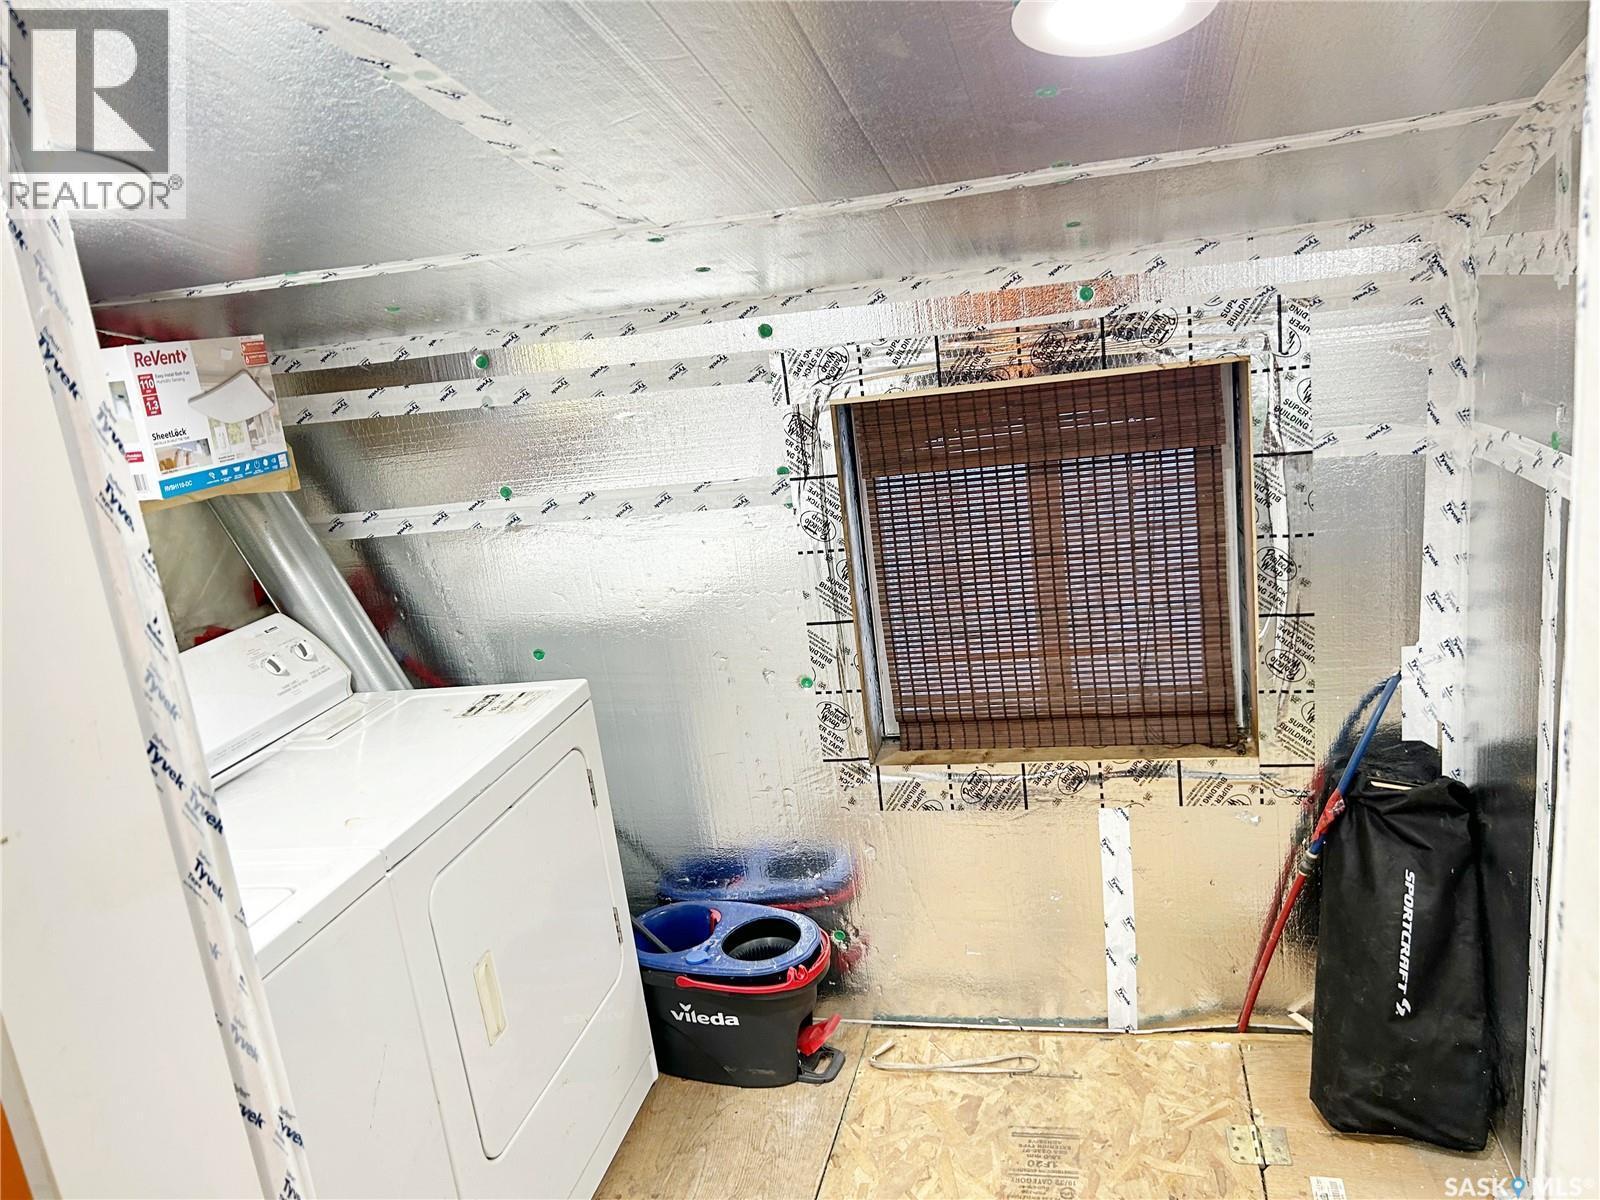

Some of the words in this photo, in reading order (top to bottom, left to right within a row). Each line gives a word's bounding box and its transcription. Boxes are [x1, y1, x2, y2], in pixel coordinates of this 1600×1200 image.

[1348, 223, 1375, 240] Tyvek
[1294, 237, 1319, 254] Tyvek
[1431, 252, 1448, 277] Tyvek
[1352, 285, 1378, 301] Tyvek
[1439, 305, 1456, 329] Tyvek
[38, 332, 83, 400] Tyvek
[134, 350, 182, 367] ReVent
[668, 364, 687, 381] Tyvek
[140, 379, 154, 390] 110
[146, 401, 159, 411] 1.3
[1283, 398, 1308, 415] SUPER
[1274, 405, 1309, 429] BUILDING
[152, 428, 187, 441] SheetLock
[1365, 424, 1391, 440] Tyvek
[1438, 452, 1455, 476] Tyvek
[1446, 502, 1463, 525] Tyvek
[1424, 545, 1440, 567] Tyvek
[819, 582, 849, 602] BUILDING
[1267, 579, 1288, 597] STICK
[1267, 592, 1285, 607] TAPE
[1430, 592, 1445, 613] Tyvek
[145, 668, 182, 722] Tyvek
[821, 713, 840, 729] Wrap
[1288, 718, 1311, 734] SUPER
[827, 731, 845, 745] STICK
[1278, 722, 1311, 746] BUILDING
[829, 740, 844, 753] TAPE
[146, 740, 187, 791] Tyvek
[900, 782, 921, 809] BUILDING
[912, 788, 927, 809] SUPER
[189, 788, 224, 834] Tyvek
[194, 858, 224, 902] Tyvek
[1398, 869, 1416, 995] SPORTCRAFT
[670, 1002, 740, 1026] vileda
[1027, 1160, 1058, 1169] 1F20
